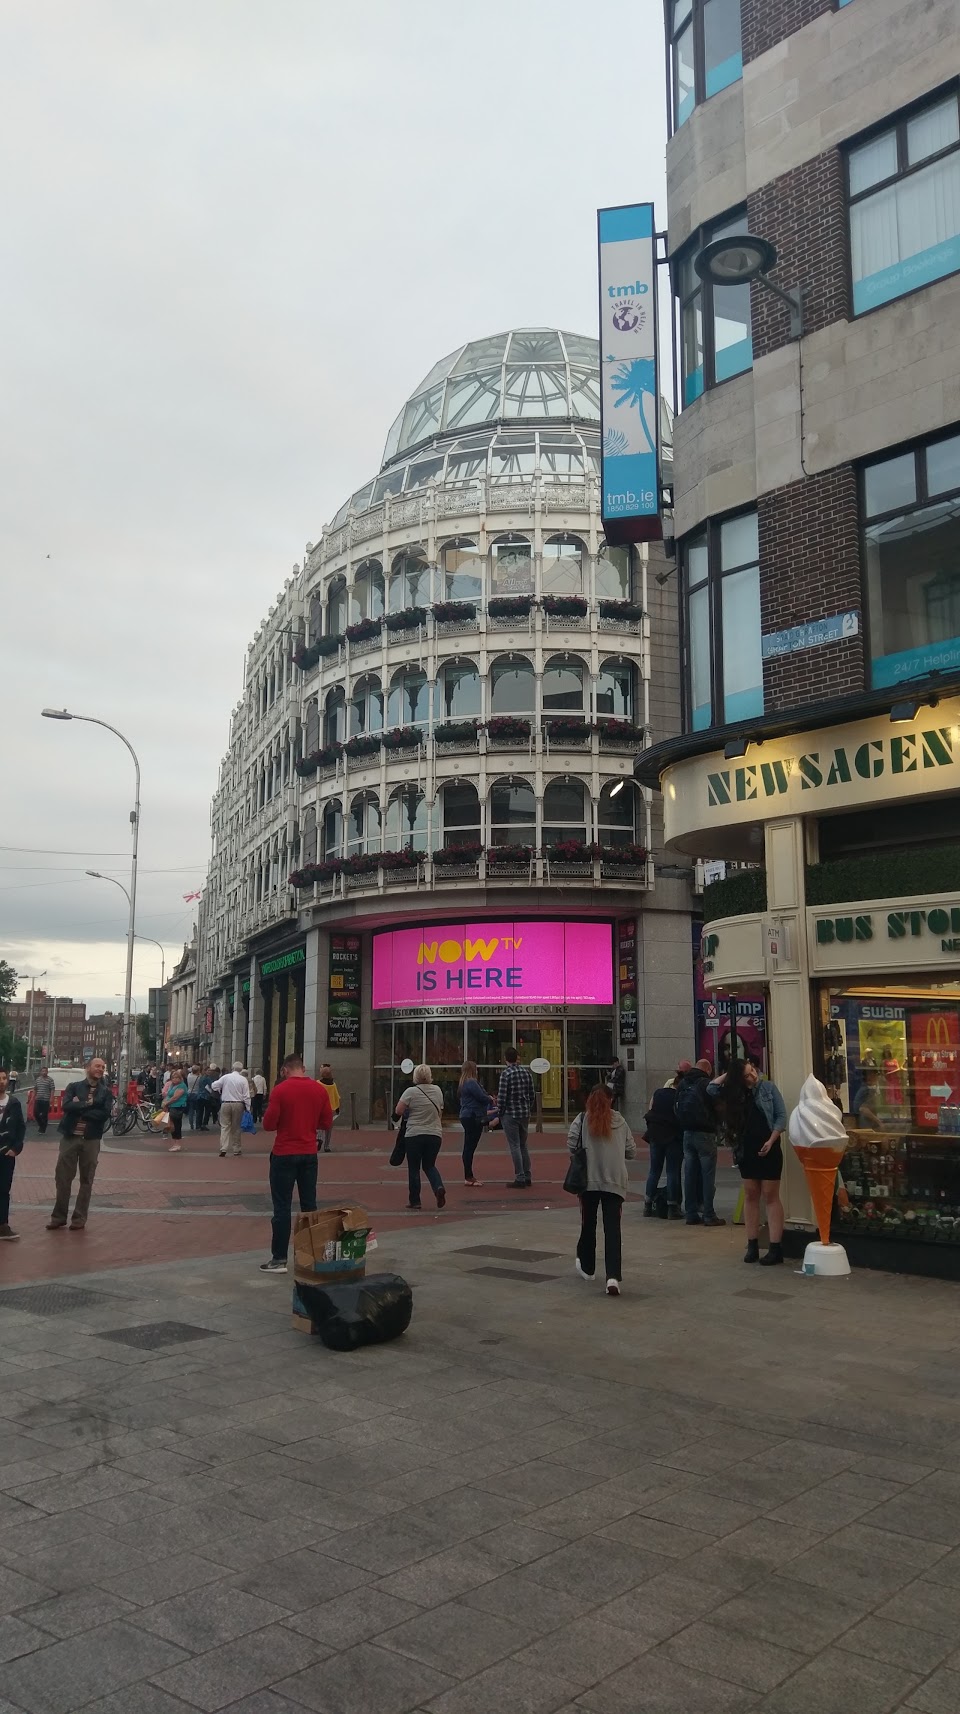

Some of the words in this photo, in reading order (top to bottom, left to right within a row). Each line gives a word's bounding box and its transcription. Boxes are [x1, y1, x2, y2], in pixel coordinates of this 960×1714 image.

[866, 272, 900, 293] Group
[902, 248, 953, 276] Bookings
[608, 281, 649, 297] tmb
[611, 299, 634, 311] TRAVEL
[607, 489, 654, 505] tmb.ie
[607, 504, 624, 512] 1850
[625, 503, 639, 511] 829
[846, 618, 854, 630] 2
[767, 637, 805, 655] GRAFTON
[808, 629, 839, 644] STREET
[894, 658, 920, 675] 24/7
[708, 725, 960, 807] NEWSAGEN
[767, 928, 780, 938] ATM
[816, 915, 873, 943] BUS
[332, 952, 358, 961] ROCKET'S
[417, 937, 500, 965] NOW
[500, 937, 523, 950] TV
[416, 970, 437, 991] IS
[446, 967, 523, 990] HERE
[436, 1006, 468, 1015] GREEN
[469, 1005, 523, 1014] SHOPPING
[525, 1005, 570, 1014] CENTRE
[924, 1111, 938, 1120] Open
